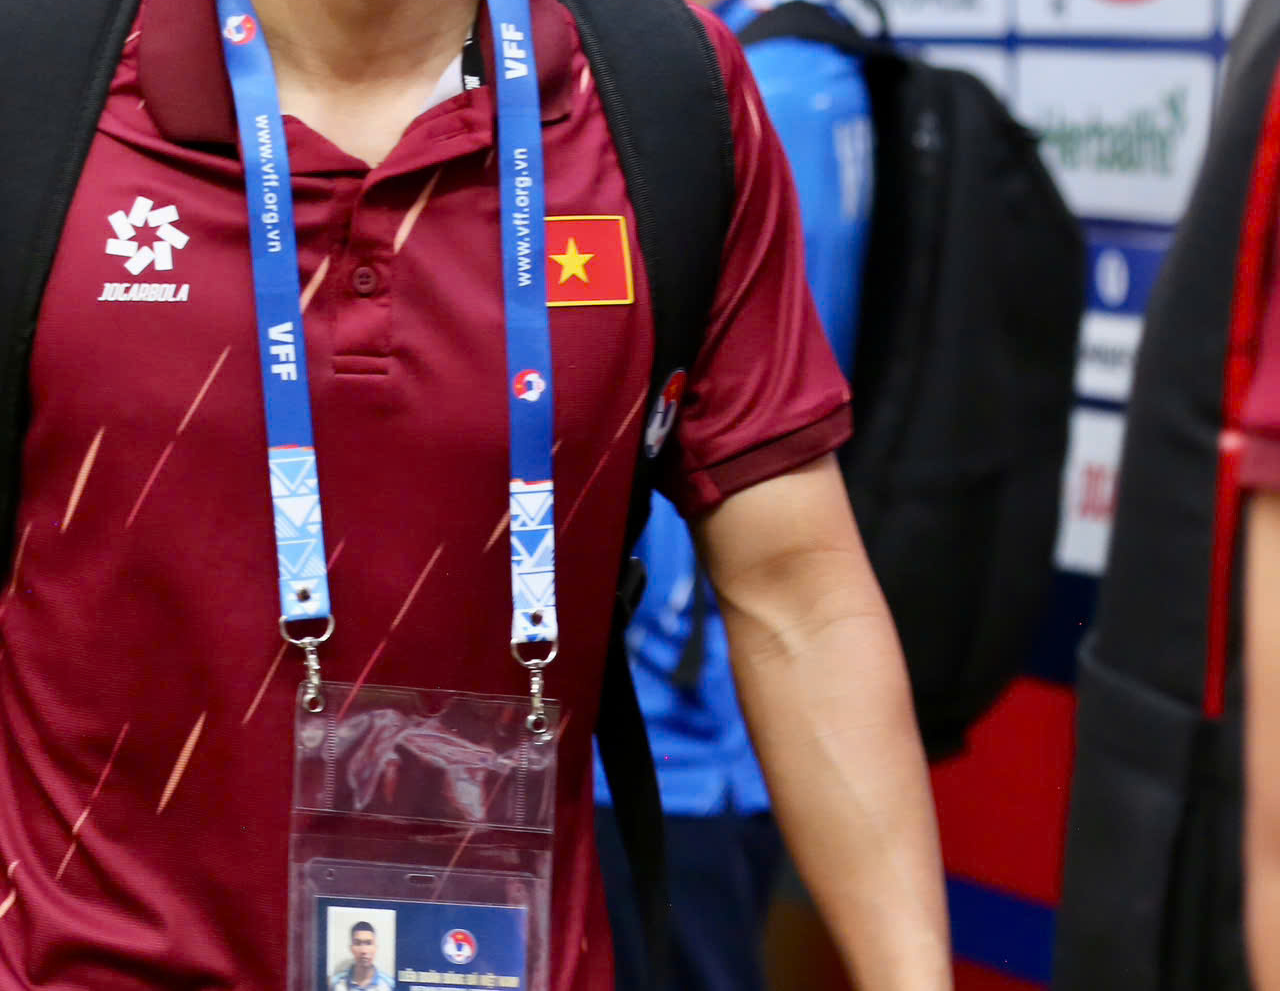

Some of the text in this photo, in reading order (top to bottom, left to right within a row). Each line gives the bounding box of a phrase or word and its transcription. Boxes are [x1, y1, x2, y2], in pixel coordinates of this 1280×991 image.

[501, 23, 529, 80] VFF
[255, 114, 282, 253] www.vff.org.vn
[513, 148, 533, 287] www.vff.org.vn
[268, 321, 298, 381] VFF
